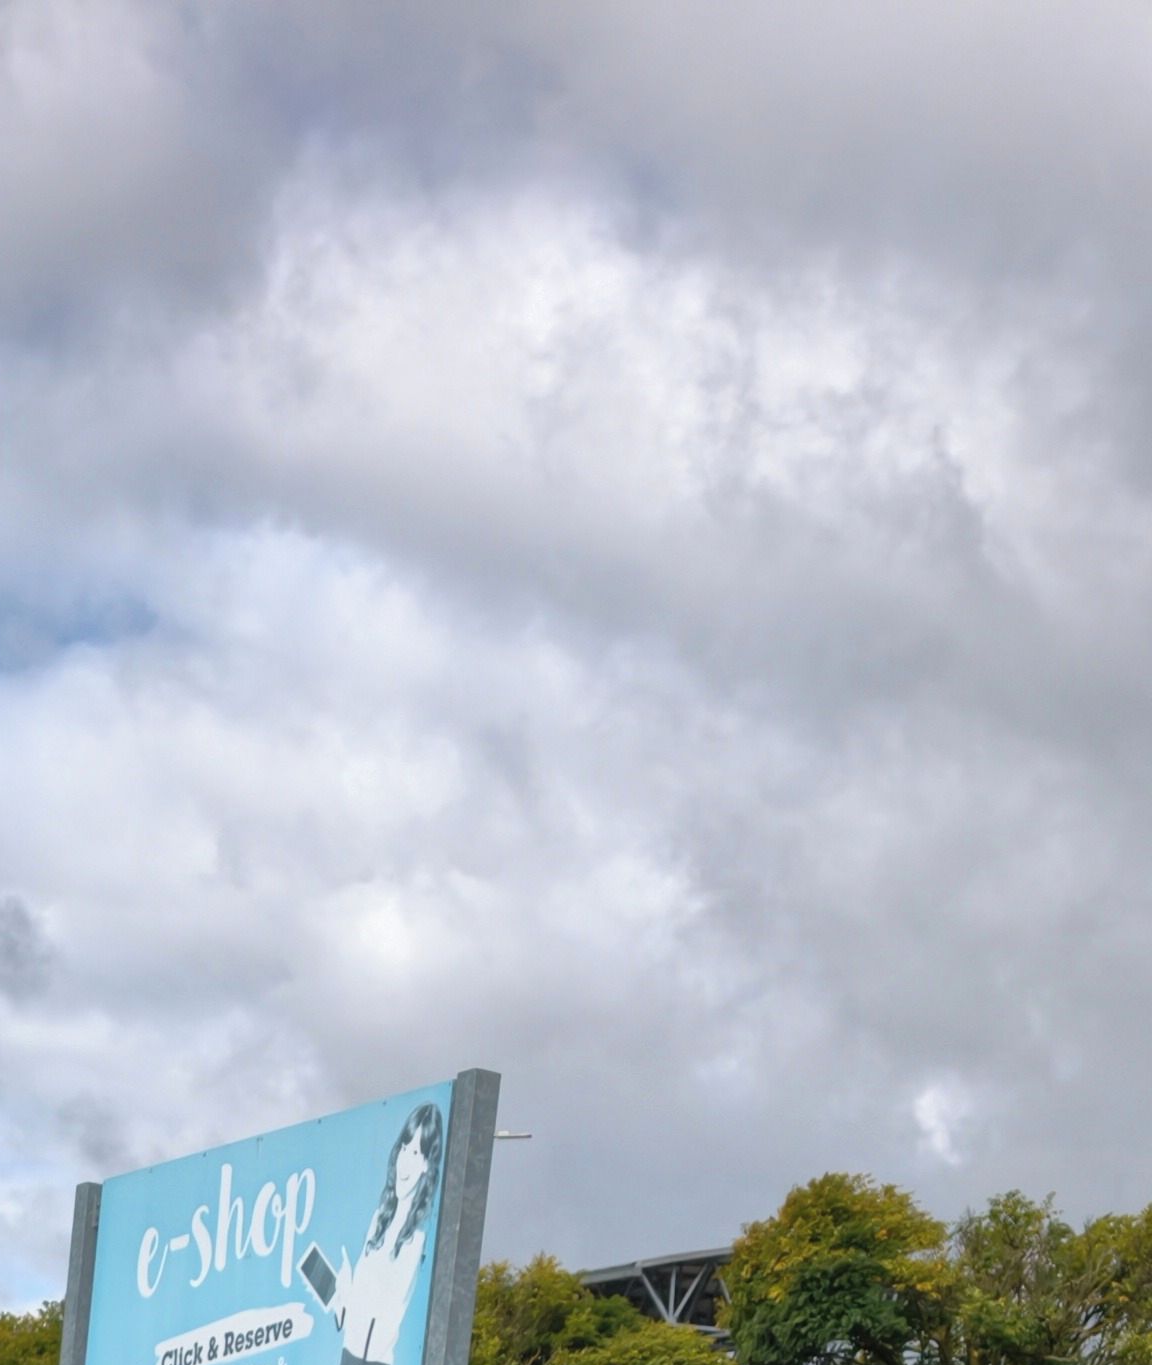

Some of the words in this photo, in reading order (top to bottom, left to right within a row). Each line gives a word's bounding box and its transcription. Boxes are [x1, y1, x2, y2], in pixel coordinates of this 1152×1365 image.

[137, 1163, 316, 1298] e-shop
[207, 1336, 219, 1362] &
[223, 1318, 293, 1357] Reserve
